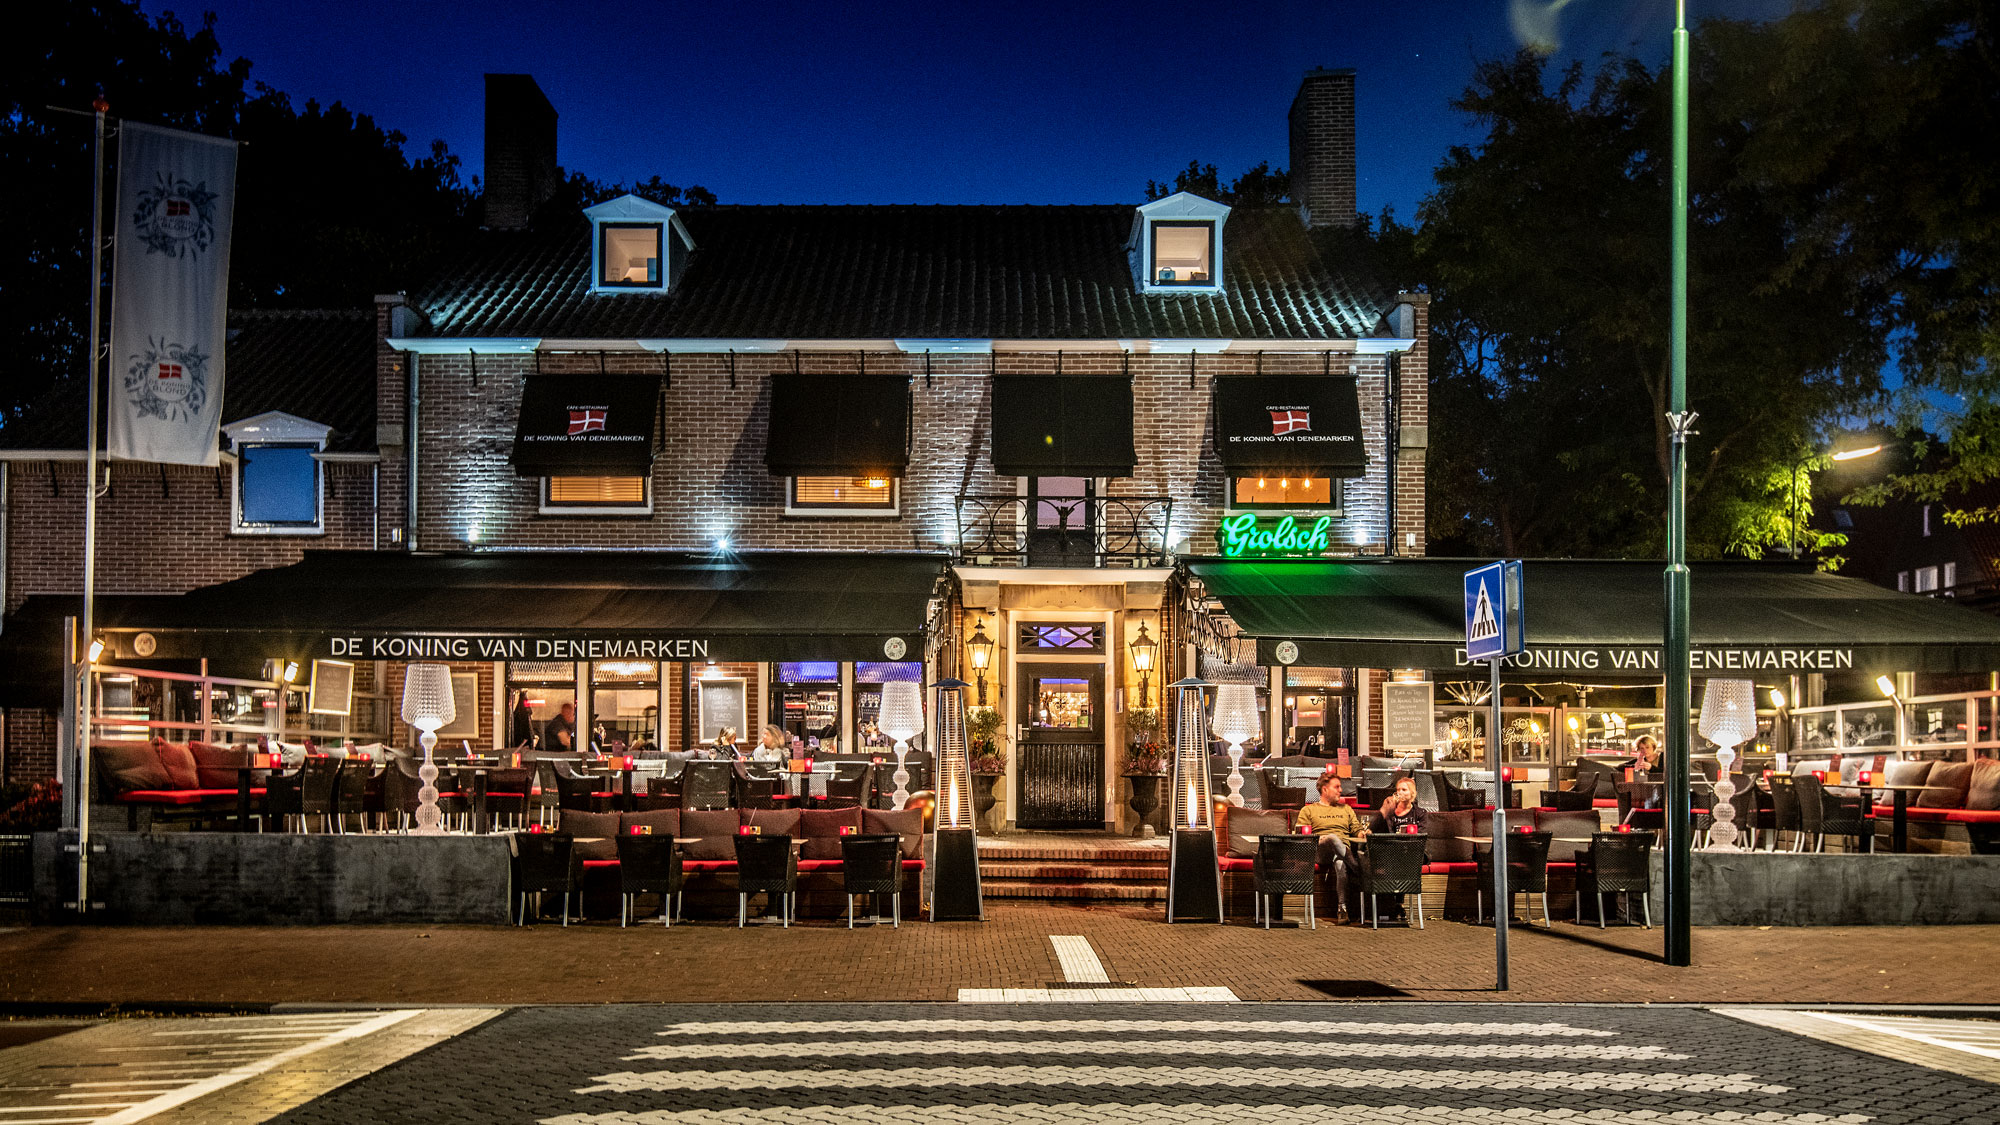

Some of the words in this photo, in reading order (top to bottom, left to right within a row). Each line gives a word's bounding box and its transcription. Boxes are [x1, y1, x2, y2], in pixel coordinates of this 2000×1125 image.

[1223, 513, 1331, 556] Grolsch
[331, 637, 363, 656] DE
[372, 637, 469, 657] KONING
[477, 639, 526, 657] VAN
[536, 639, 709, 659] DENEMARKEN
[1608, 650, 1659, 669] VAN
[1688, 650, 1853, 669] ENEMARKEN
